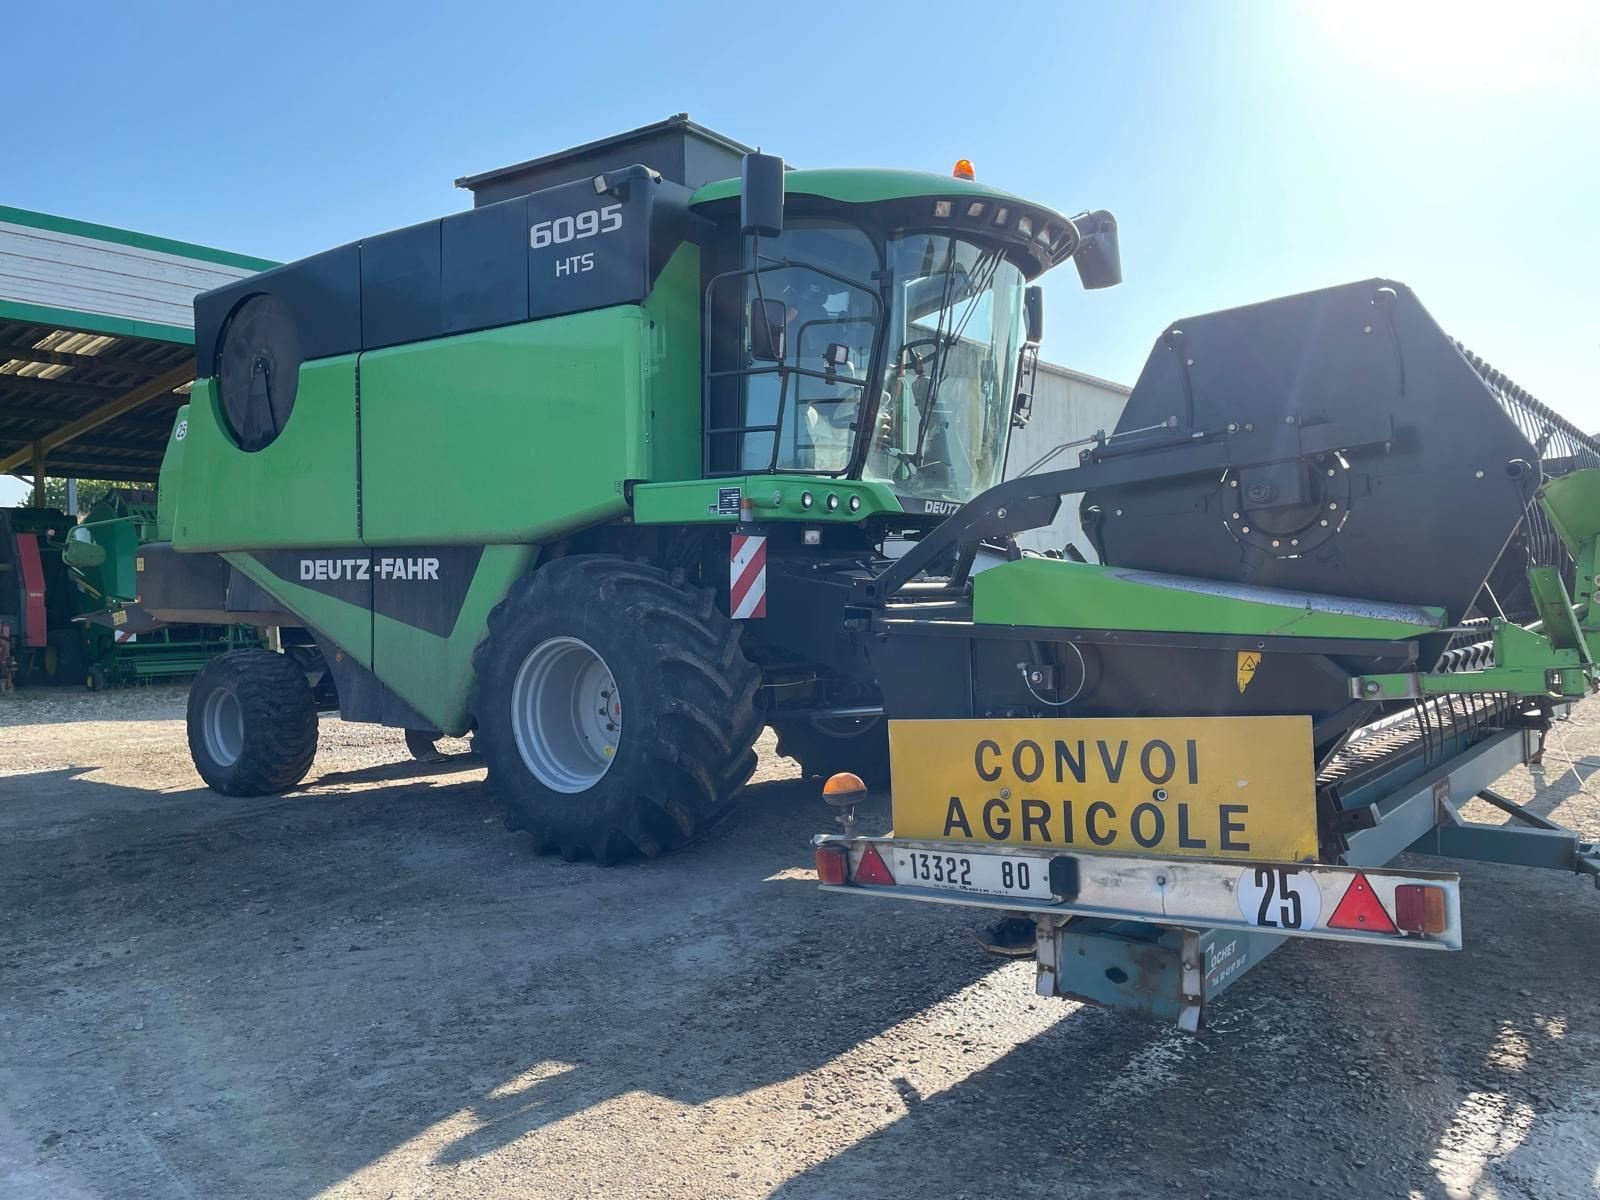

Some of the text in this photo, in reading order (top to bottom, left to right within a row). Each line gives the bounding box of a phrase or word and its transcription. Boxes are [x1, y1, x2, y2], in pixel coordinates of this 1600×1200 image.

[530, 203, 623, 249] 6095
[555, 252, 594, 277] HTS
[176, 423, 187, 438] 25
[974, 739, 1199, 785] CONVOI
[943, 796, 1250, 852] AGRICOLE
[910, 853, 1030, 890] 13322 80
[1254, 866, 1302, 929] 25
